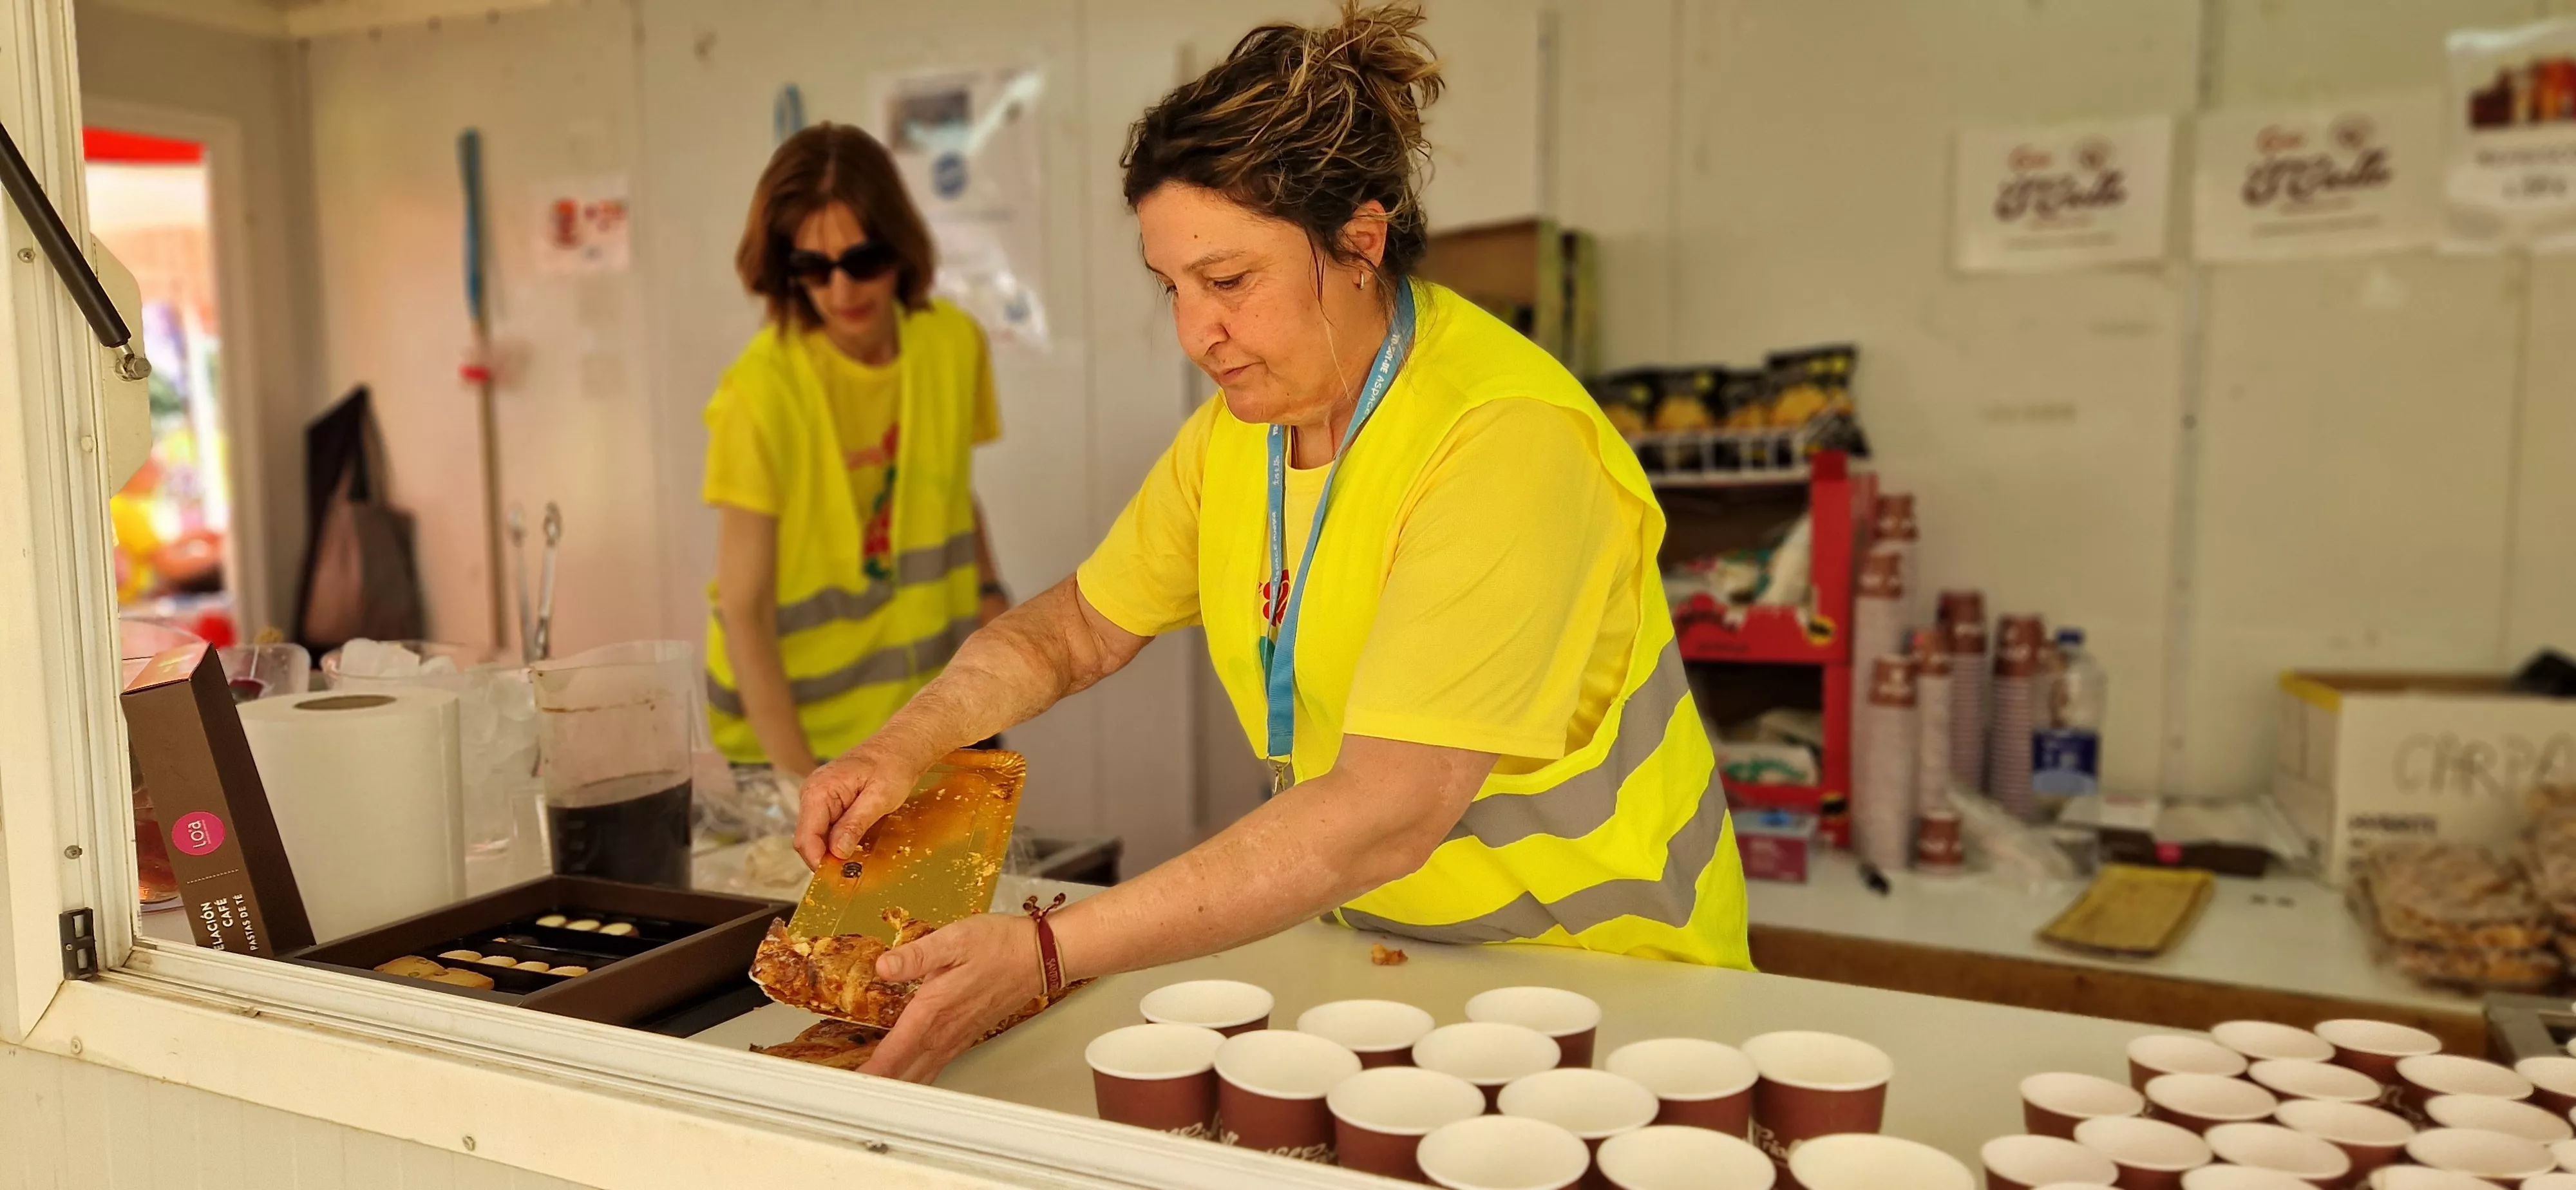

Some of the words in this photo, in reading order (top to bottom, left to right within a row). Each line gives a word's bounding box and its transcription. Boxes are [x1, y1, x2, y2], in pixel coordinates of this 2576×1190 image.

[232, 894, 245, 905] TÉ
[214, 898, 234, 927] CAFÉ
[238, 906, 249, 918] DE
[242, 920, 260, 951] PASTAS
